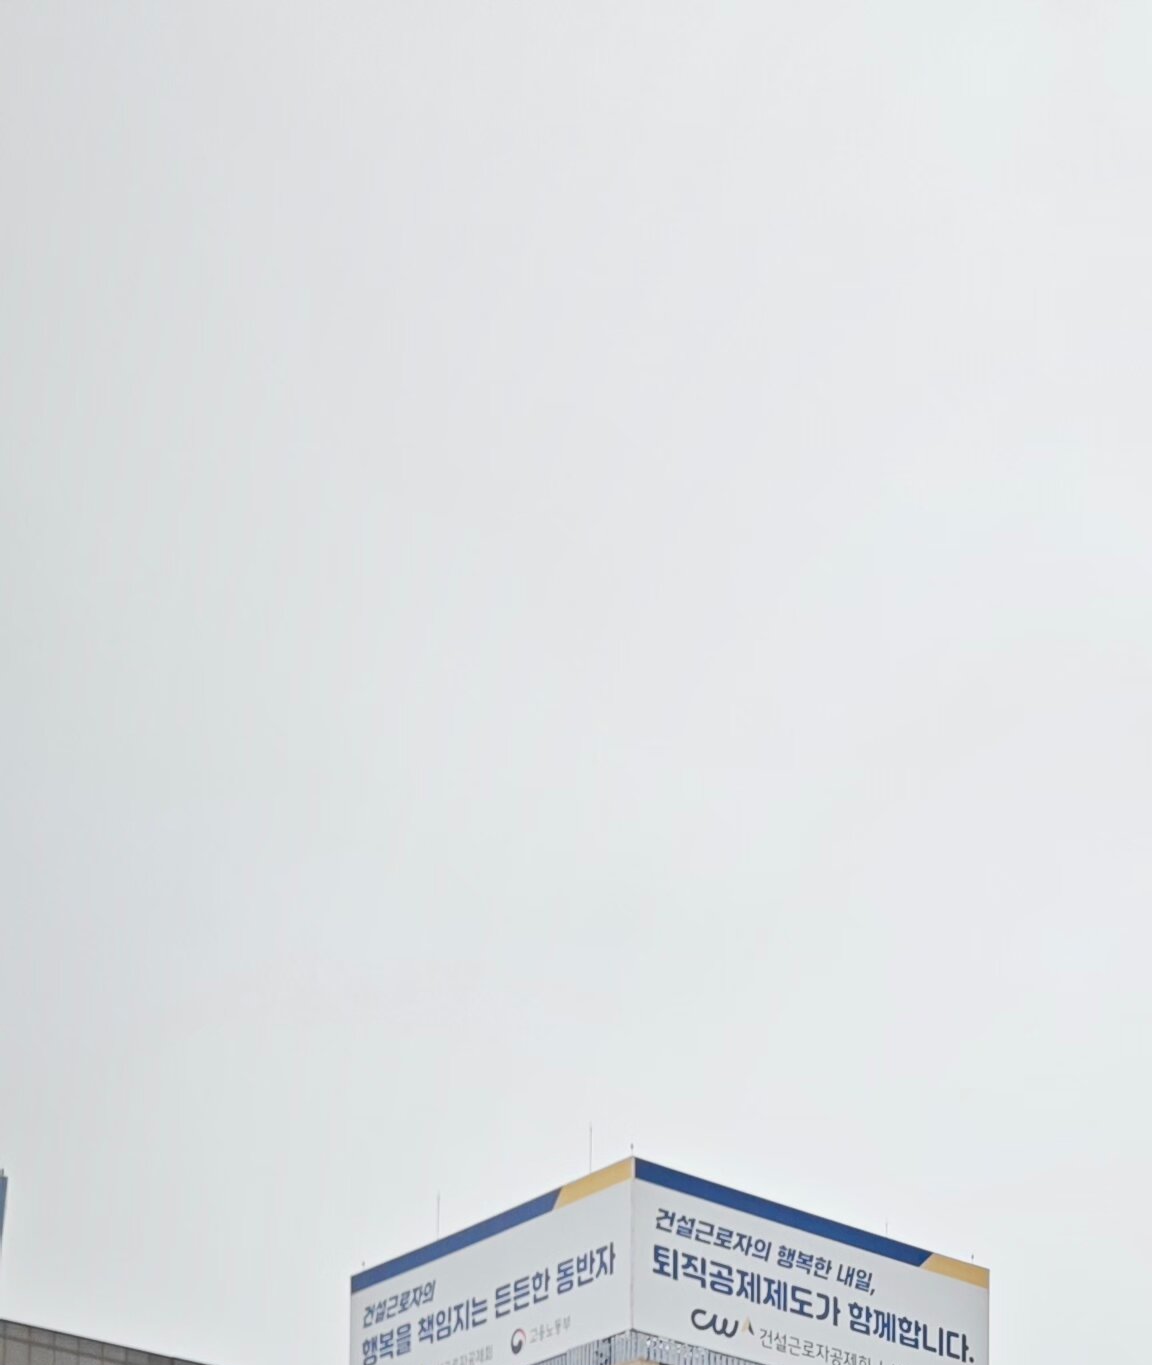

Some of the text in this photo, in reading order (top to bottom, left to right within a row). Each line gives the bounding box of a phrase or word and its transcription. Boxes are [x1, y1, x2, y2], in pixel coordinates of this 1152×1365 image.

[418, 1296, 488, 1344] 책임지는
[494, 1267, 551, 1318] 든든한
[556, 1241, 616, 1295] 동반자
[655, 1207, 876, 1296] 건설근로자의 행복한 내일,
[362, 1280, 436, 1329] 건설근로자의
[652, 1244, 975, 1363] 퇴직공제제도가 함께합니다.
